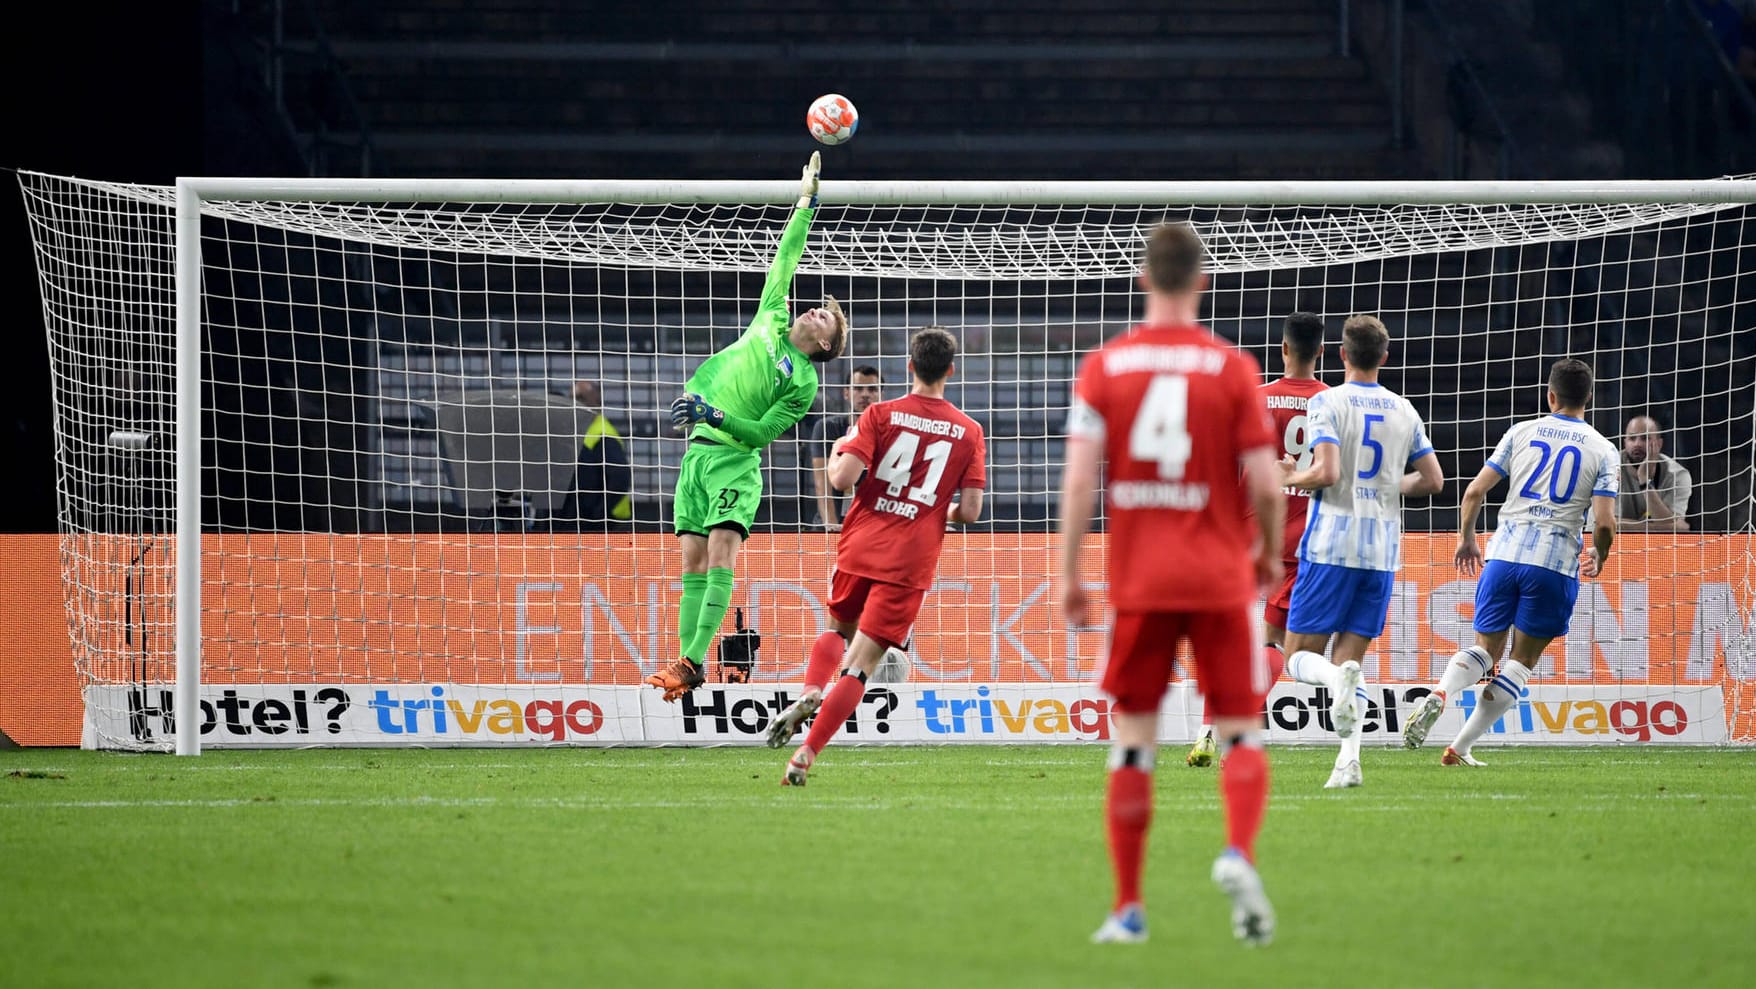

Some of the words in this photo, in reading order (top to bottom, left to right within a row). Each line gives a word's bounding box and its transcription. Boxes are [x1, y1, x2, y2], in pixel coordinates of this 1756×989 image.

[890, 411, 950, 436] HAMBURGER
[950, 424, 966, 440] SV
[1130, 374, 1193, 481] 4
[1349, 395, 1381, 409] HERTHA
[1383, 398, 1397, 409] BSC
[1284, 415, 1314, 472] 9
[1358, 414, 1384, 479] 5
[1536, 426, 1570, 440] HERTHA
[1571, 431, 1587, 445] BSC
[875, 431, 953, 507] 41
[1520, 440, 1582, 504] 20
[718, 488, 740, 509] 32
[874, 497, 919, 520] ROHR
[1528, 504, 1557, 519] KEMPF
[368, 686, 604, 741] trivago
[682, 687, 898, 734] Hot?
[916, 685, 1112, 741] trivag
